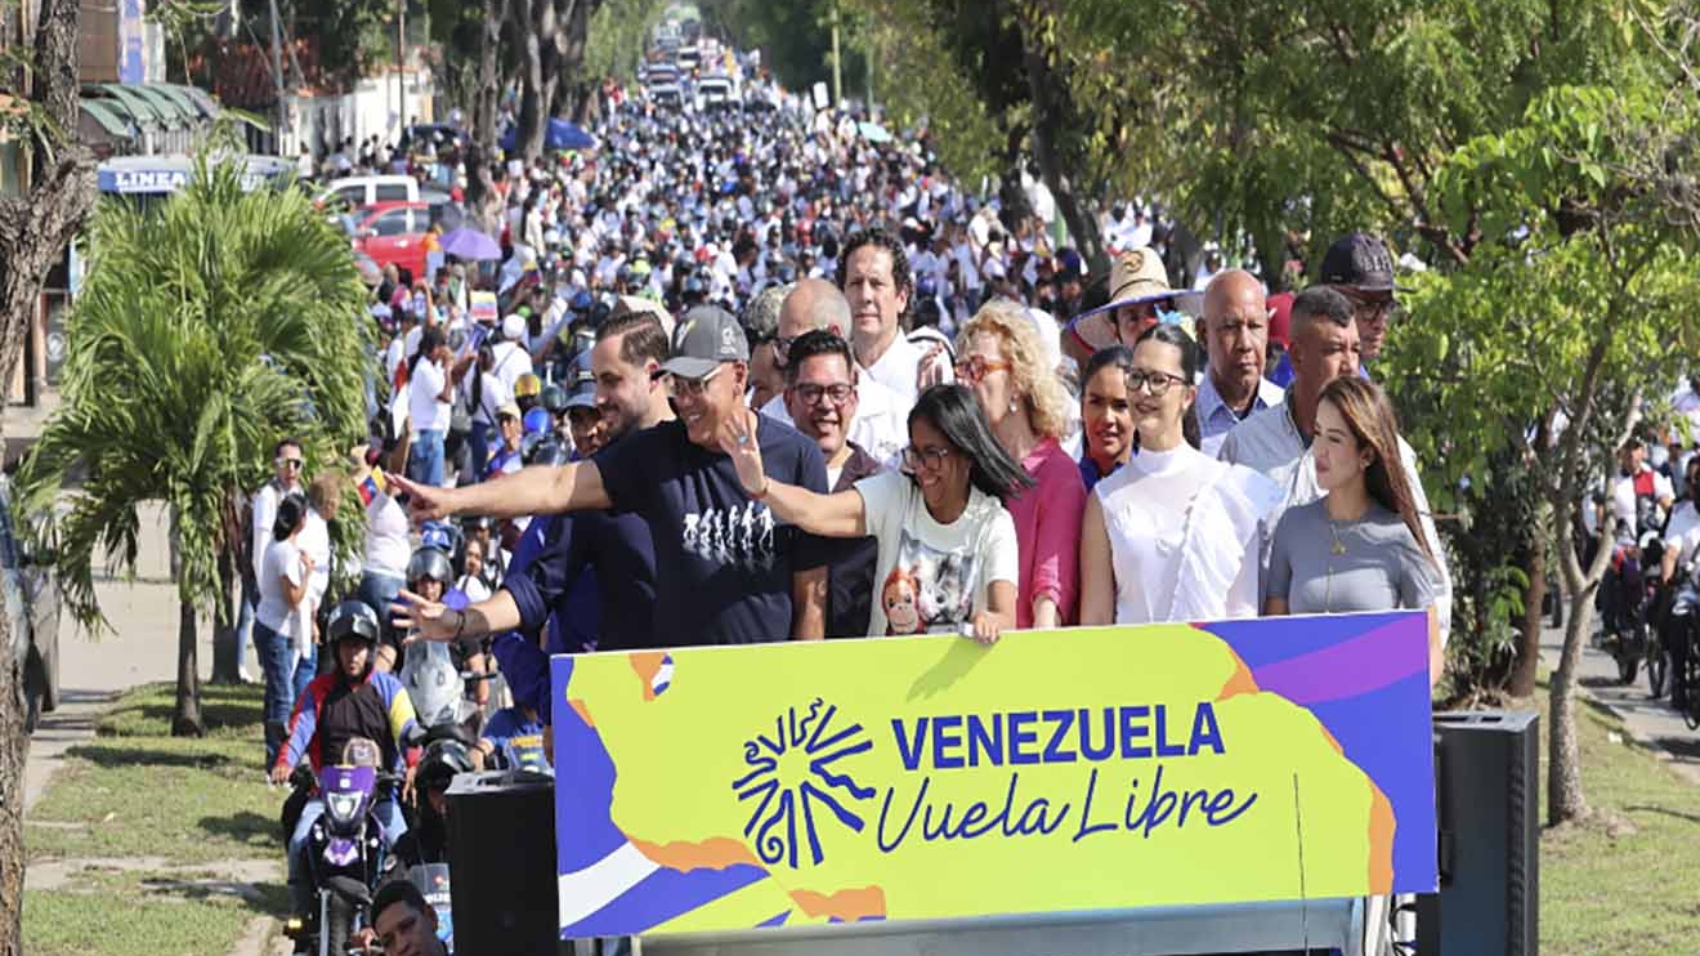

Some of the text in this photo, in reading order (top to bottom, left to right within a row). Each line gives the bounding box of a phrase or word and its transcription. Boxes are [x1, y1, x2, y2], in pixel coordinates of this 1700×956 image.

[115, 172, 186, 187] LINEA
[891, 702, 1225, 771] VENEZUELA
[877, 766, 1257, 853] Vuela Libre
